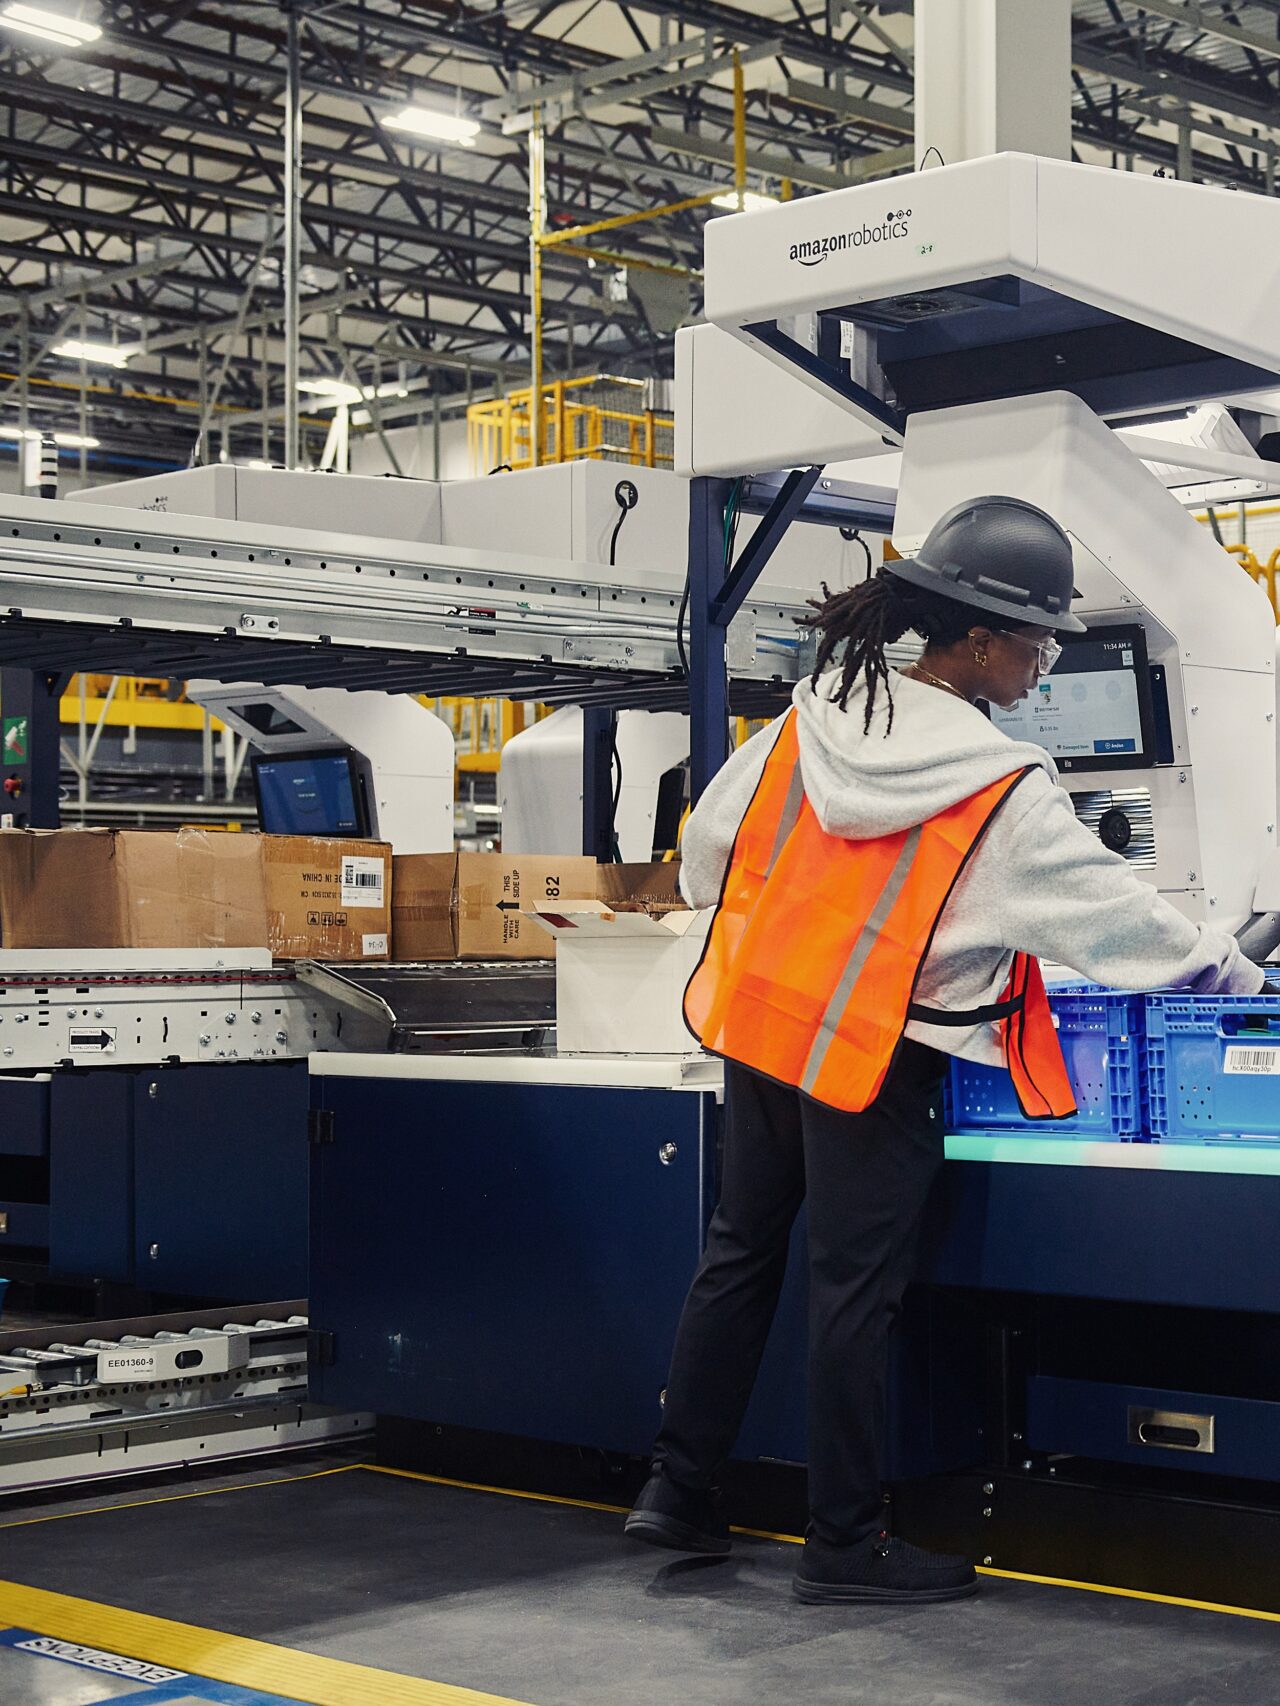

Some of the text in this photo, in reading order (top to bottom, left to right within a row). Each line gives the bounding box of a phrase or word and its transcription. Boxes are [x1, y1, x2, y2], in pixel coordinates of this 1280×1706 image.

[302, 873, 323, 882] CHINA
[325, 874, 332, 883] IN
[513, 869, 520, 880] UP
[545, 876, 560, 900] 82
[108, 1357, 154, 1368] EE01360-9
[25, 1640, 177, 1681] EXCEPTIONS
